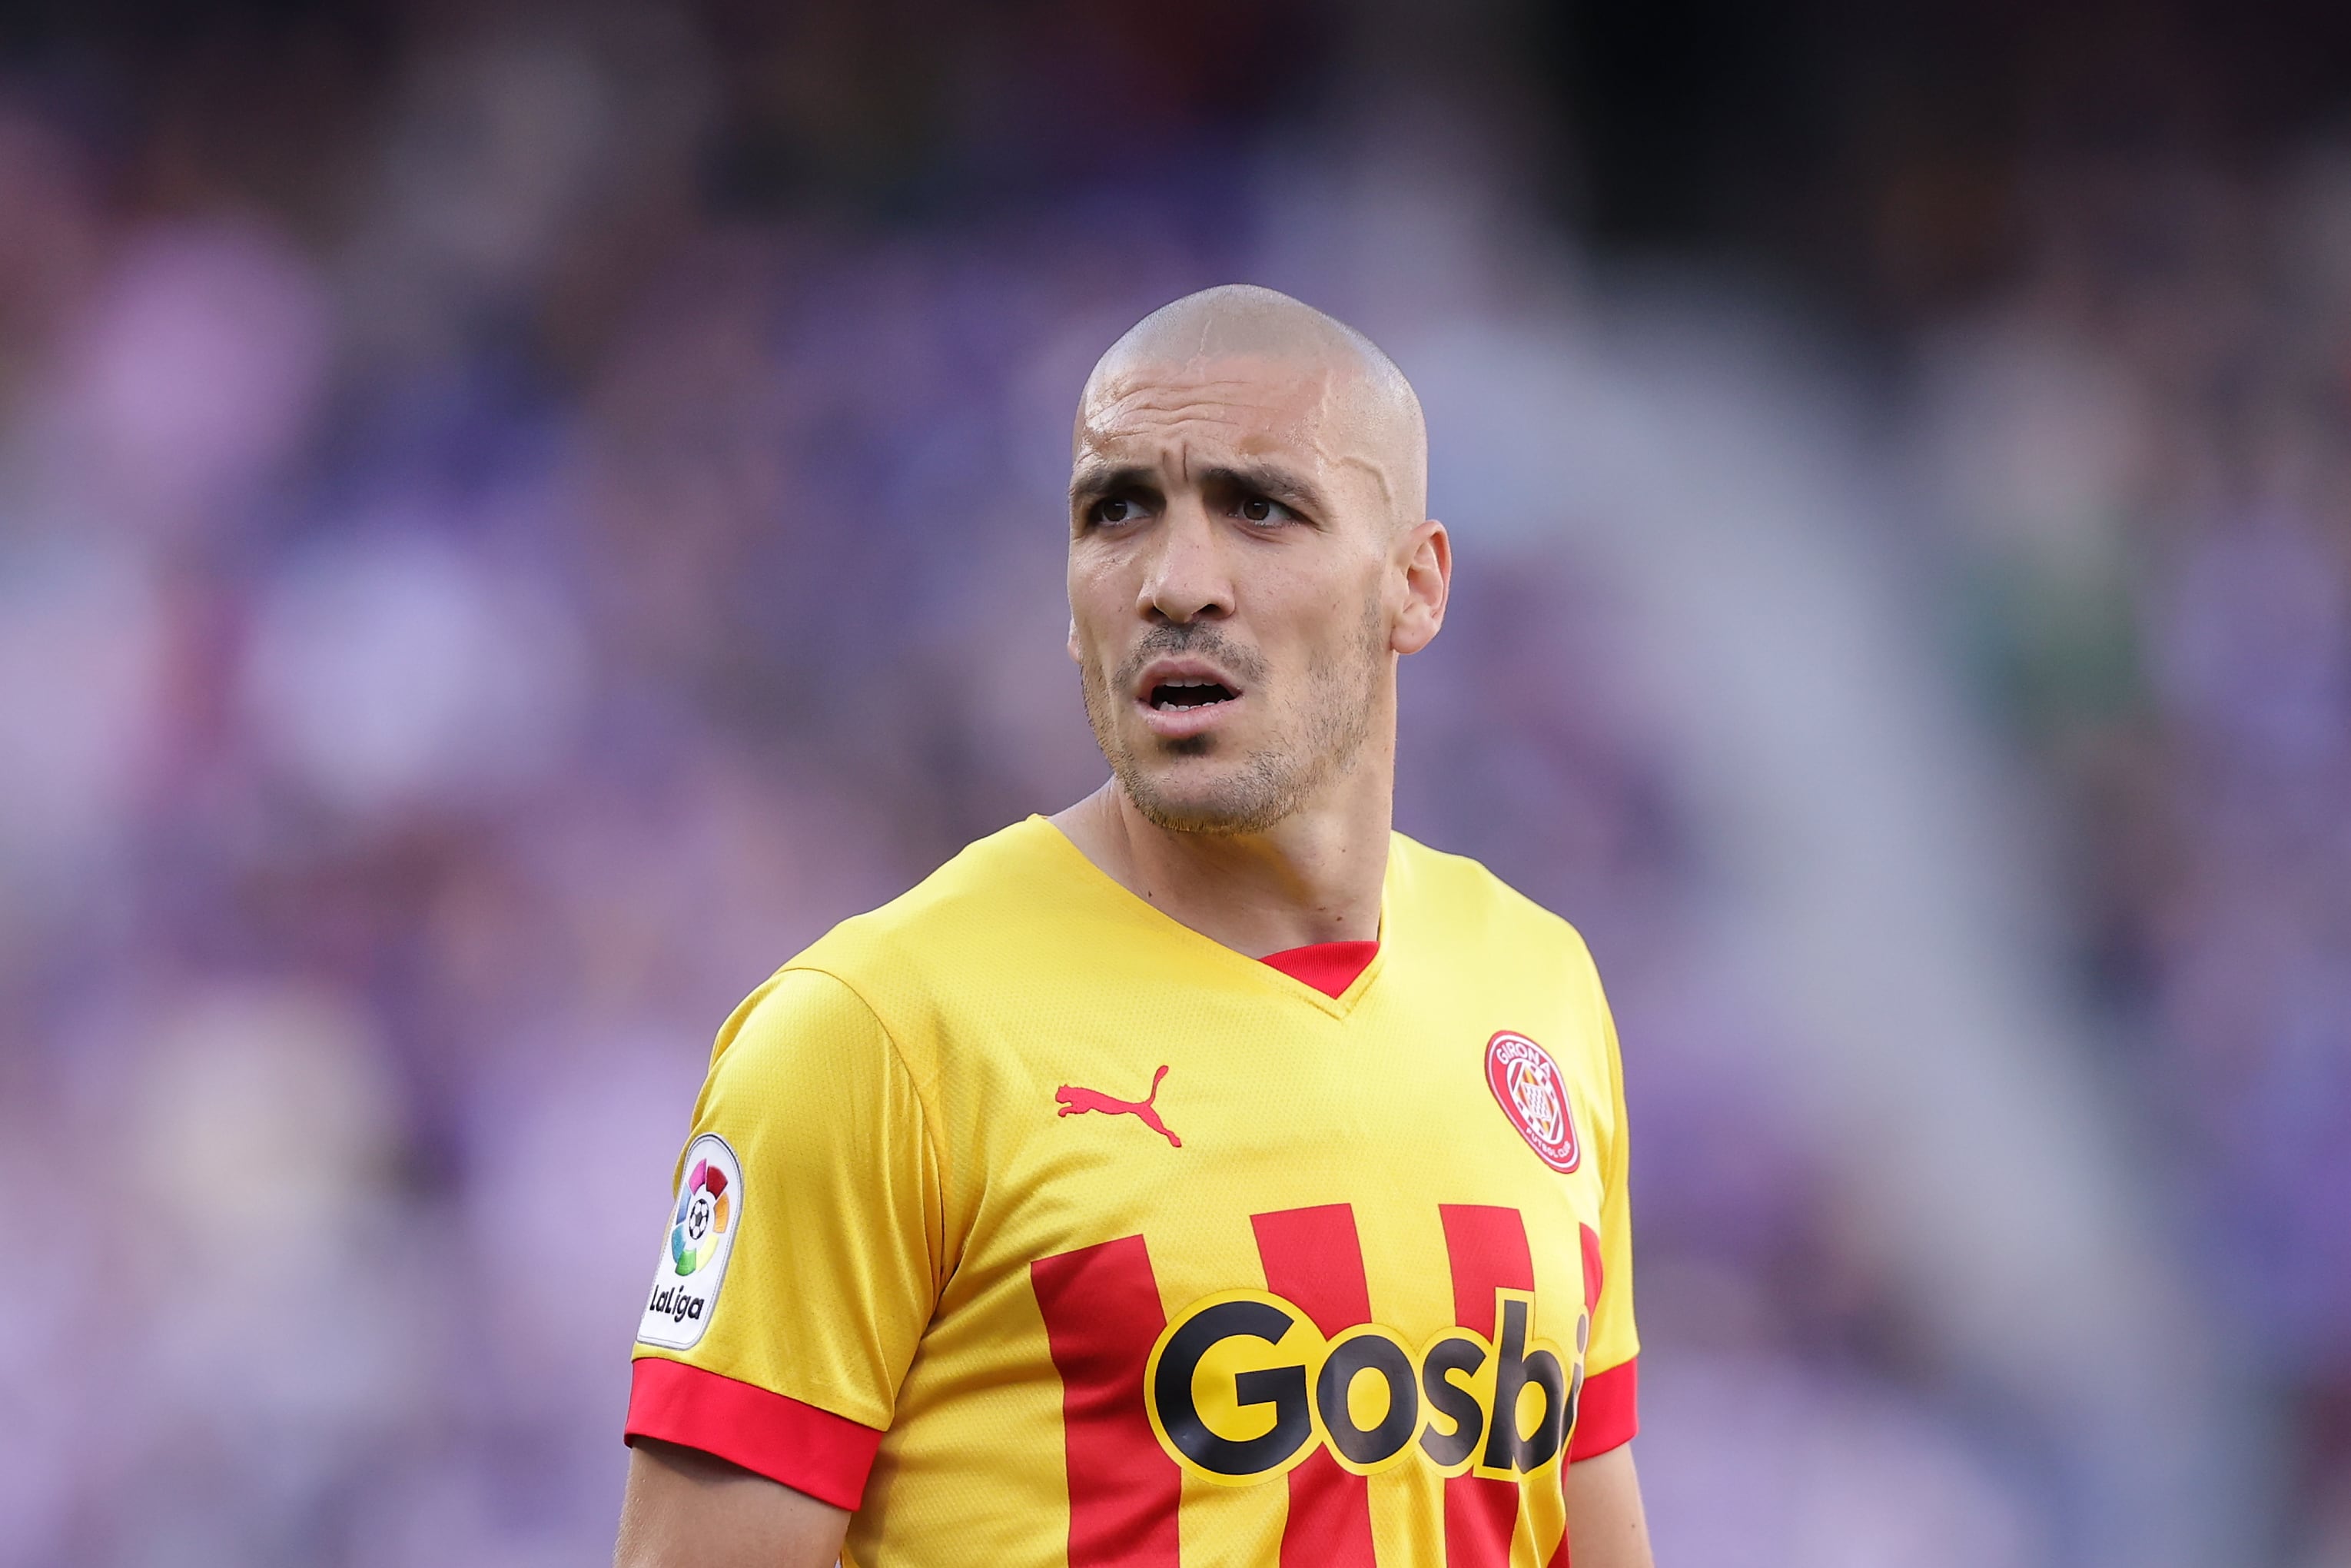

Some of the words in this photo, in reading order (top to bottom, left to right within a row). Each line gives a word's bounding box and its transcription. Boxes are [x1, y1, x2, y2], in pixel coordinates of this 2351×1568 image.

[1496, 1041, 1549, 1078] GIRONA
[649, 1284, 704, 1322] LaLiga
[1154, 1299, 1588, 1475] Gosbi
